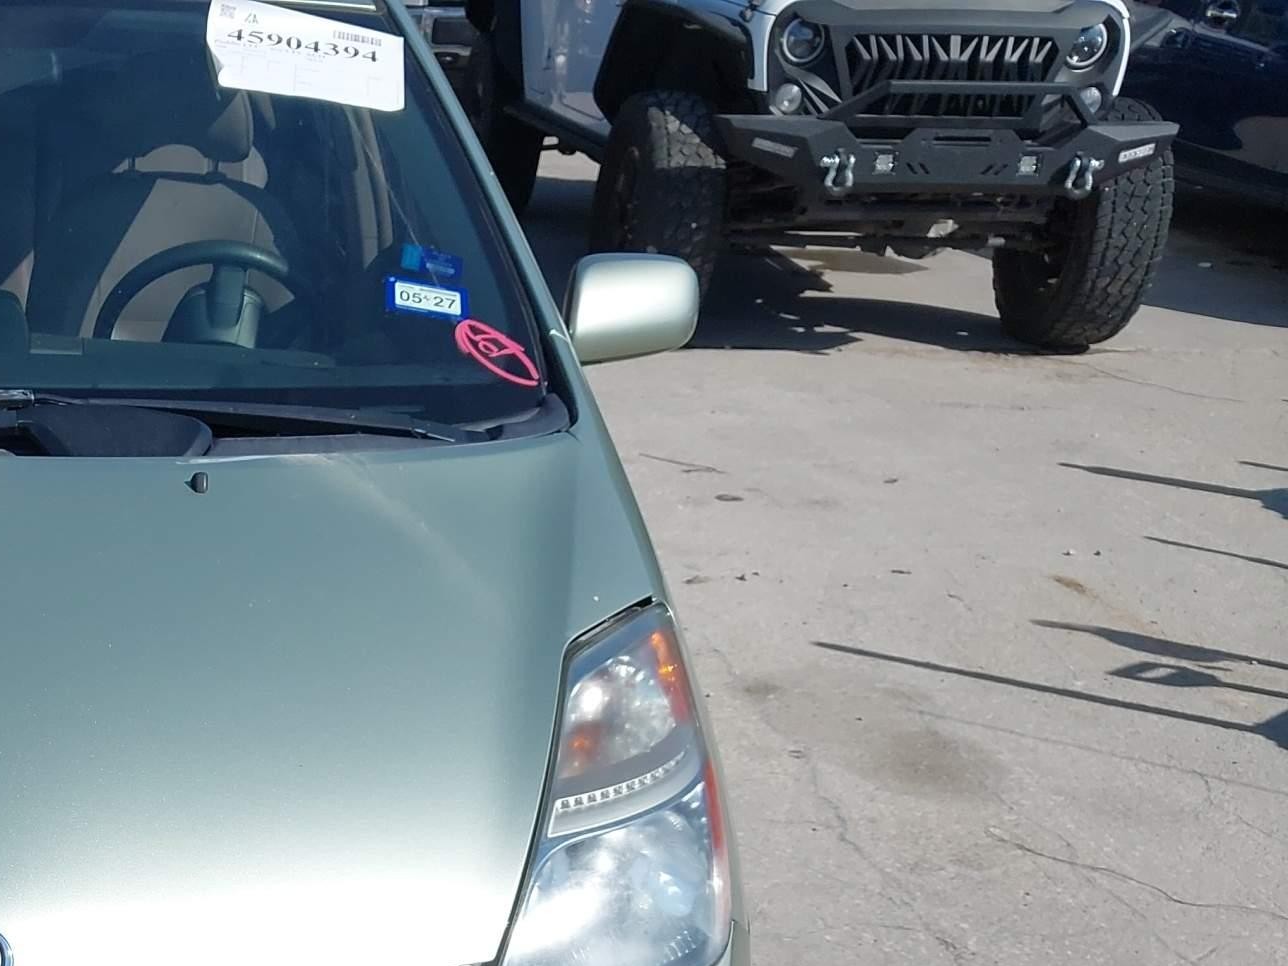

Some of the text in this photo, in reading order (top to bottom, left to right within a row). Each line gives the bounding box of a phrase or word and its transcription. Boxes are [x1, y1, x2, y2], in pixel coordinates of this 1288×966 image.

[226, 28, 379, 63] 45904394
[399, 290, 457, 309] 05 27
